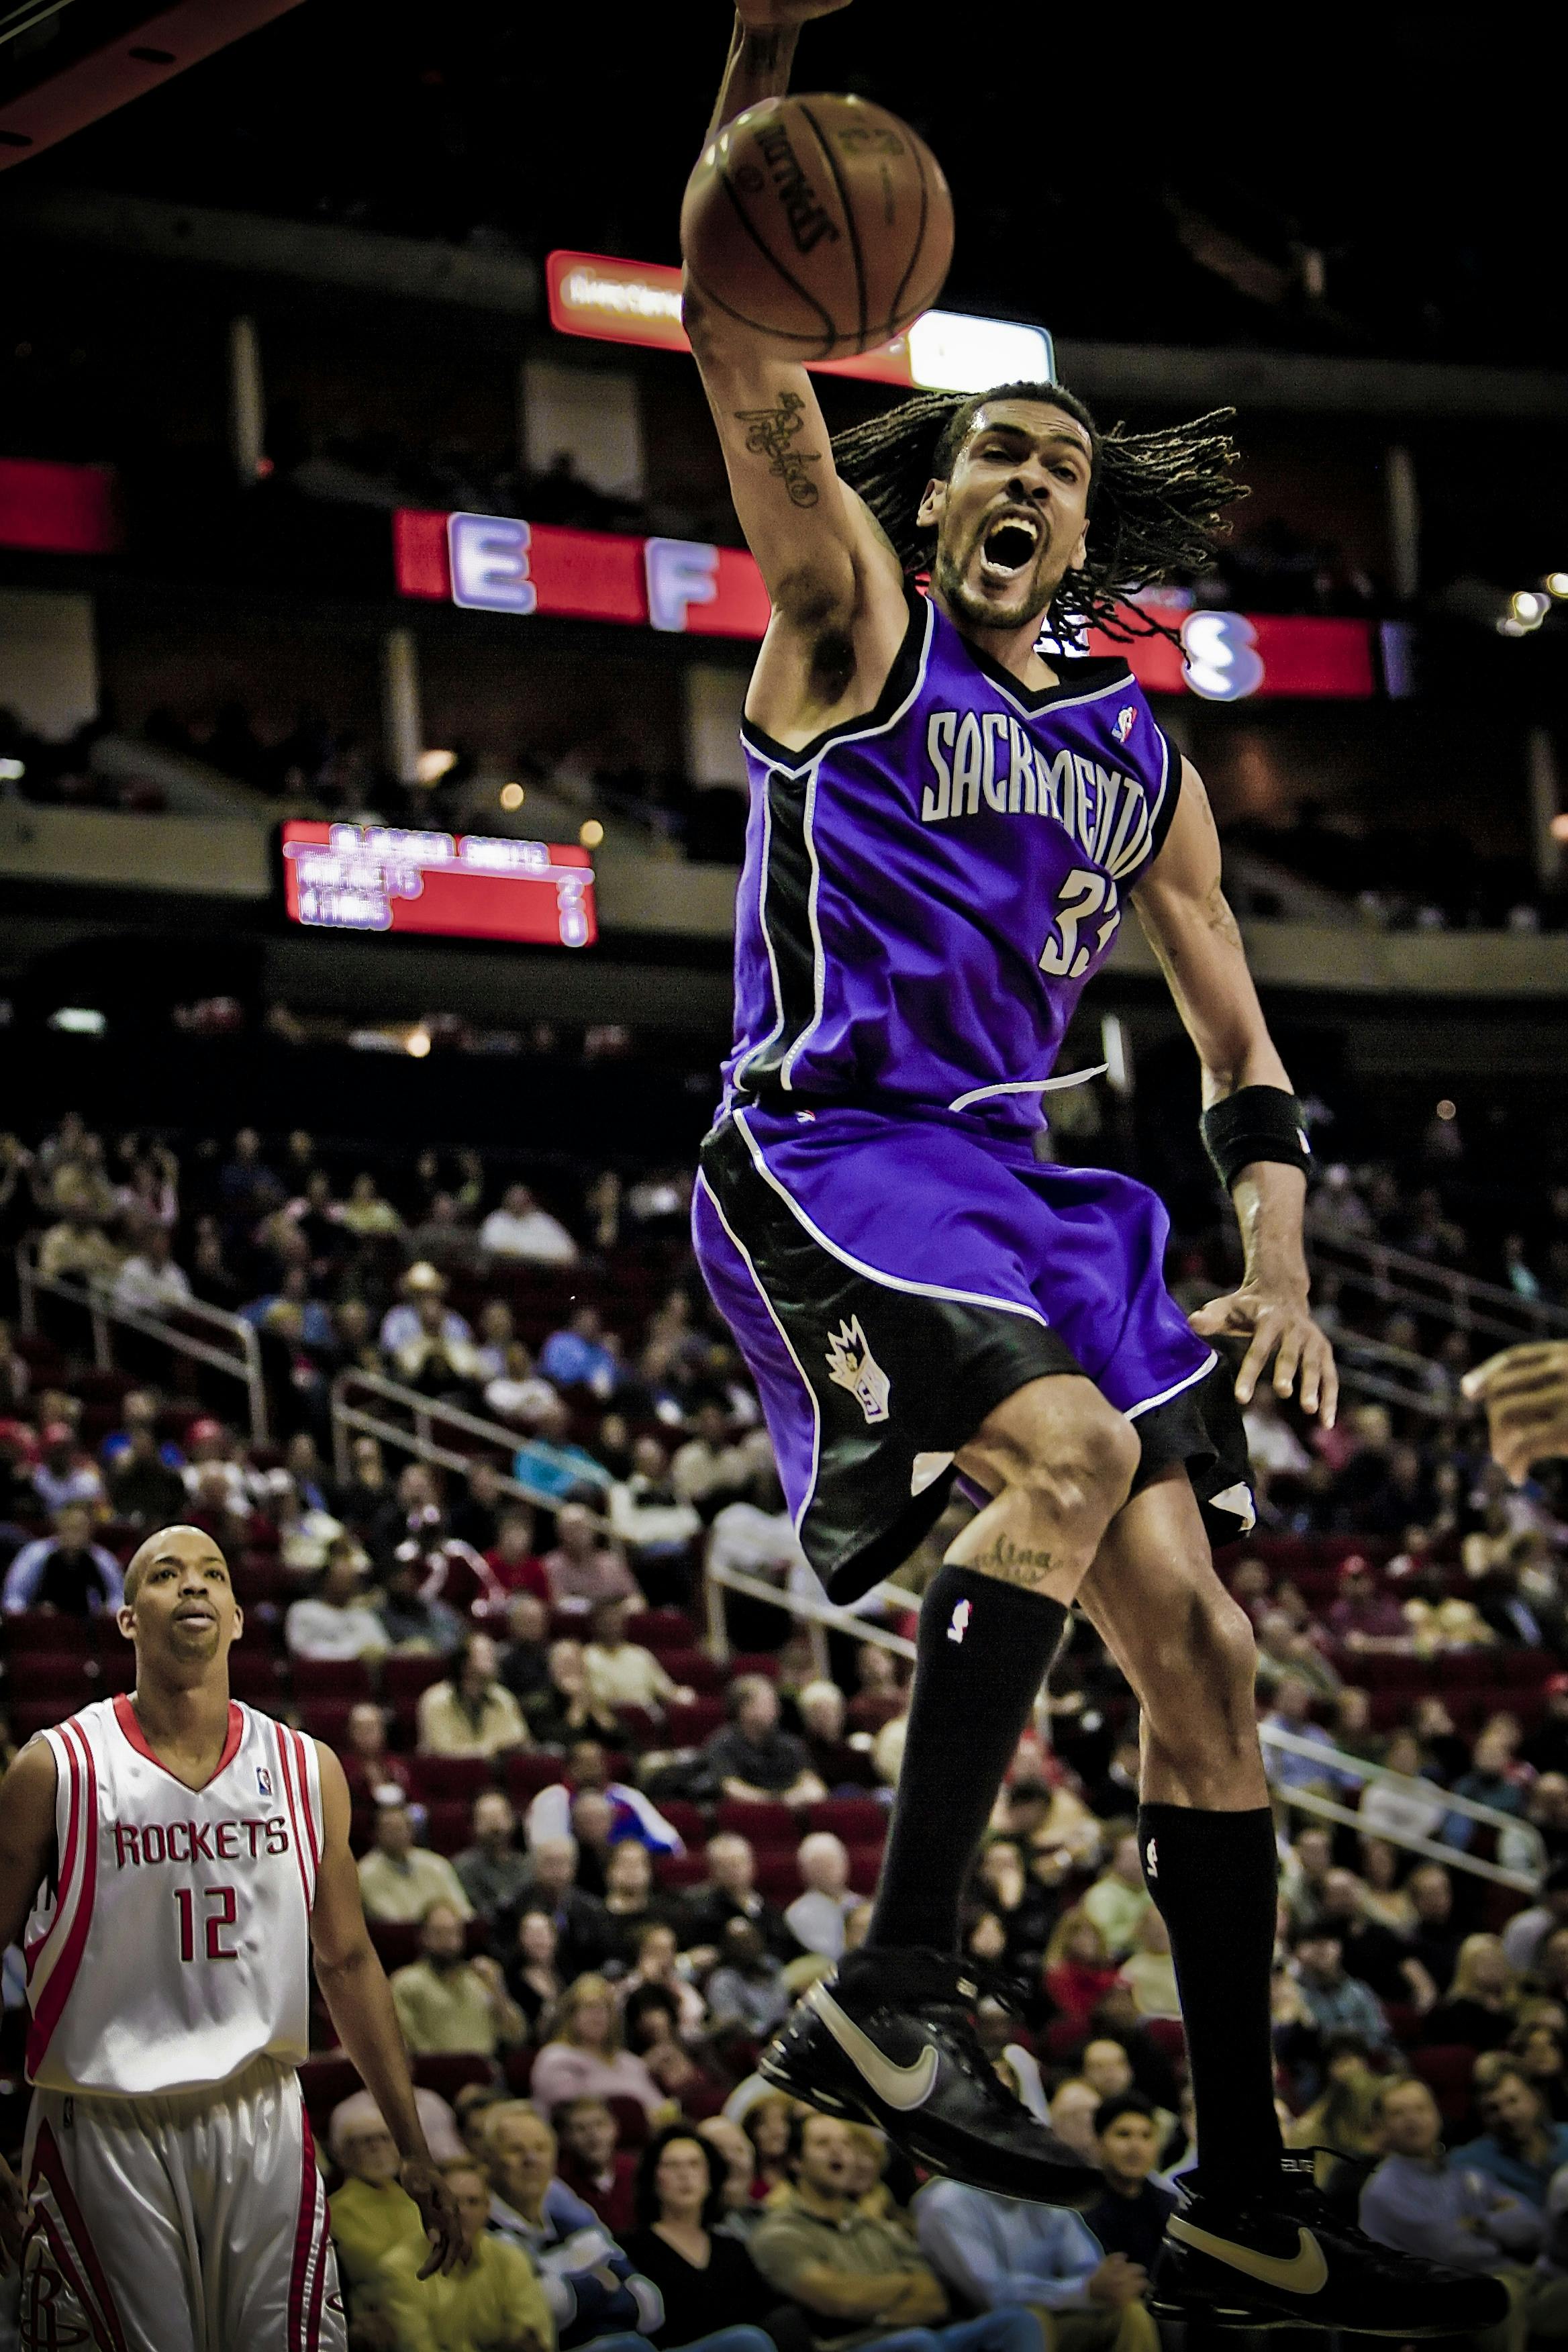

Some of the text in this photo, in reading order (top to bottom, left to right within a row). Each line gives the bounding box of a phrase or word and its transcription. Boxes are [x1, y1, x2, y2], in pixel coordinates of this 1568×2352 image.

[448, 511, 536, 614] E
[644, 537, 720, 632] F
[922, 712, 1152, 880] SACRAMENTO
[110, 1815, 289, 1870] ROCKETS
[174, 1886, 238, 1961] 12
